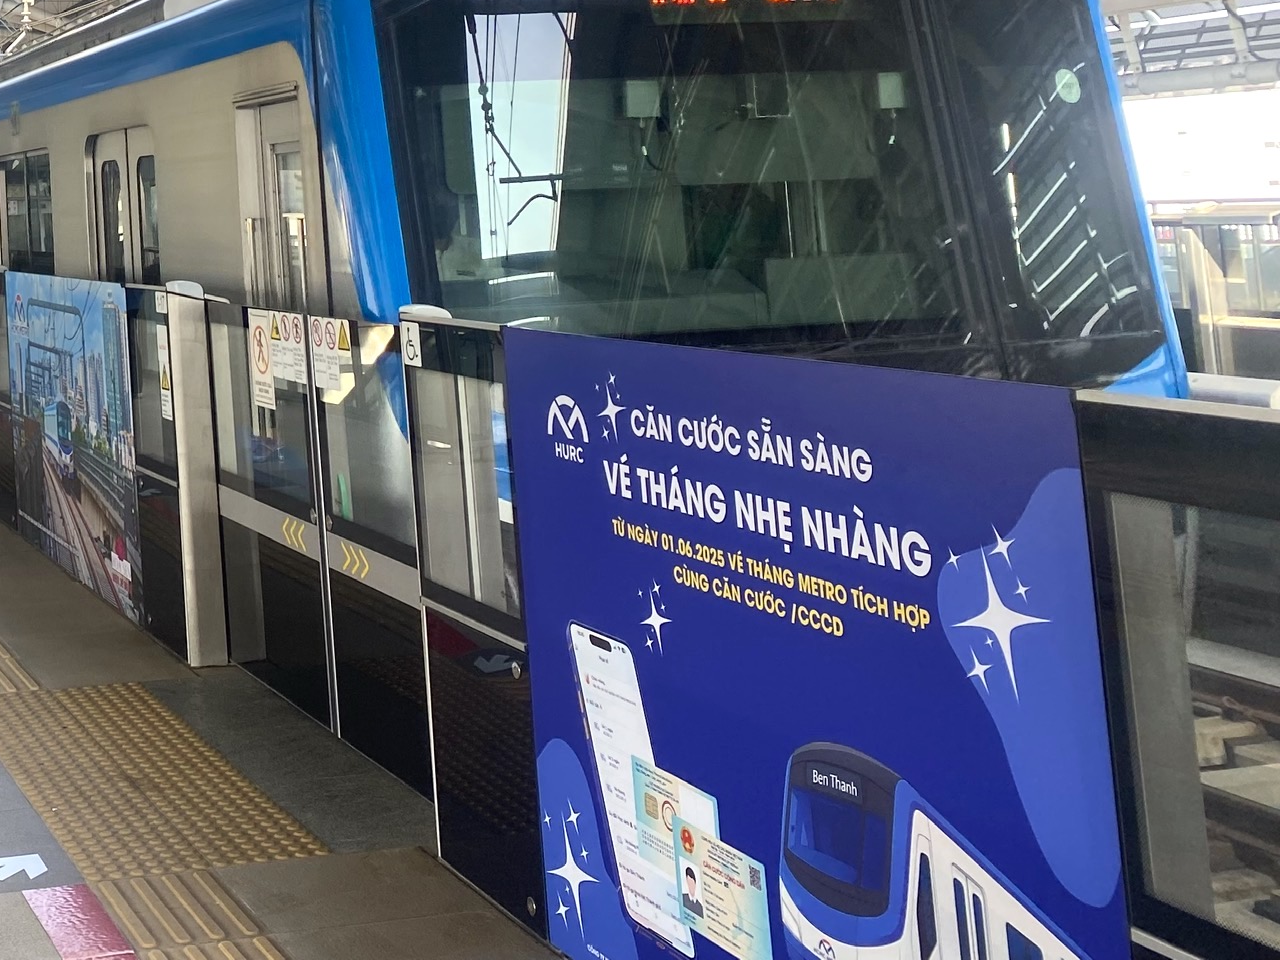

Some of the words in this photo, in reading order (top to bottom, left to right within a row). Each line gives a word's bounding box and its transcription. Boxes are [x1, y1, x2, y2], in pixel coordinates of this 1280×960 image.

[554, 441, 585, 464] HURC
[630, 404, 673, 443] CĂN
[677, 414, 742, 456] CƯỚC
[747, 416, 794, 468] SẴN
[800, 431, 873, 483] SÀNG
[602, 453, 633, 500] VÉ
[636, 465, 727, 524] THÁNG
[734, 489, 793, 554] NHẸ
[801, 504, 932, 577] NHÀNG
[611, 516, 625, 538] TỪ
[627, 522, 659, 548] NGÀY
[661, 532, 726, 568] 01.06.2025
[727, 550, 745, 574] VÉ
[746, 558, 795, 589] THÁNG
[797, 572, 848, 605] METRO
[850, 585, 890, 618] TÍCH
[893, 600, 931, 633] HỢP
[673, 563, 710, 593] CÙNG
[712, 576, 742, 604] CĂN
[744, 590, 787, 618] CƯỚC
[812, 769, 829, 786] Ben
[829, 773, 858, 797] Thanh
